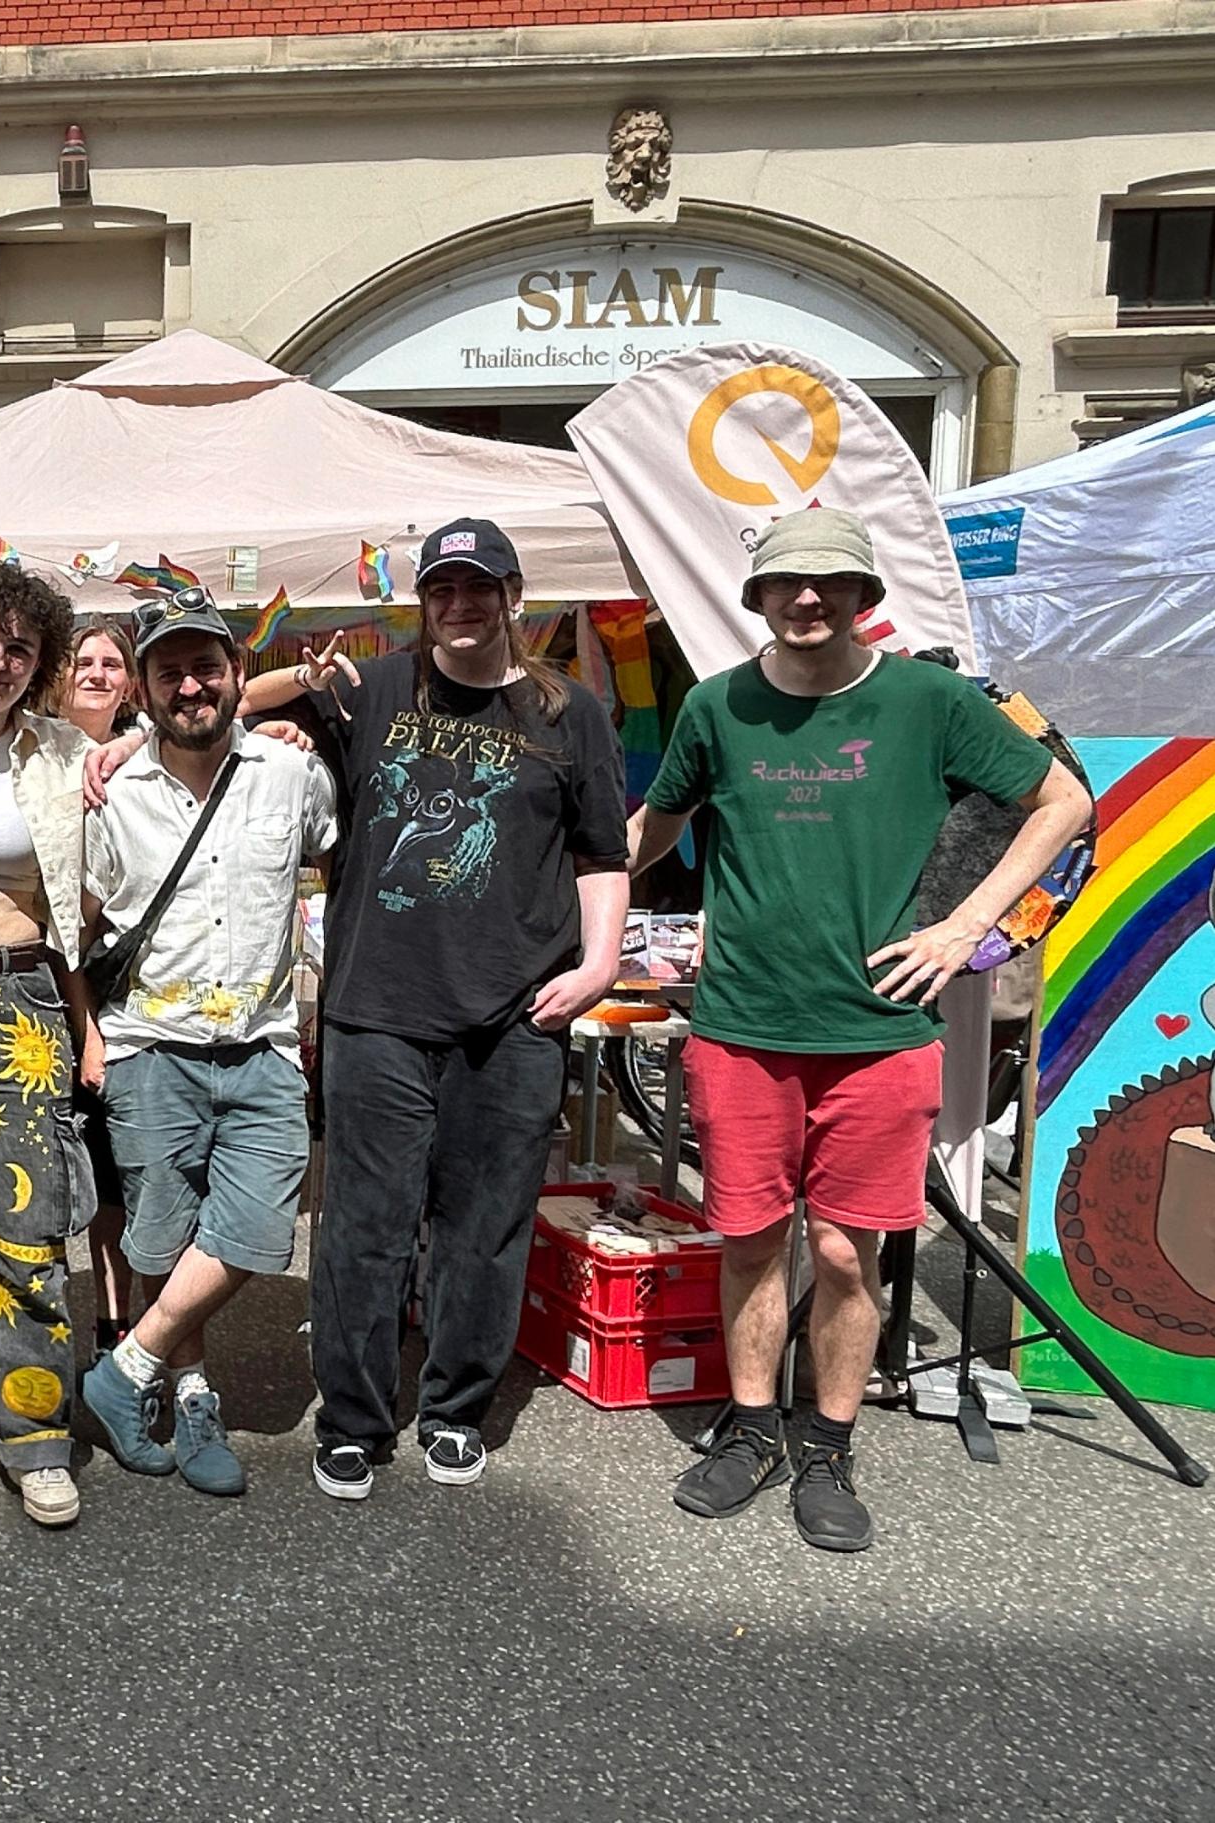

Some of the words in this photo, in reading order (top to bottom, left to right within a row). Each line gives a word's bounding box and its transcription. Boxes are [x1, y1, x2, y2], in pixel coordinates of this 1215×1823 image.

[516, 267, 724, 331] SIAM
[460, 345, 609, 369] Thailändische
[383, 722, 521, 770] PLEASE
[395, 711, 458, 732] DOCTOR
[461, 722, 528, 746] DOCTOR
[784, 785, 822, 803] 2023
